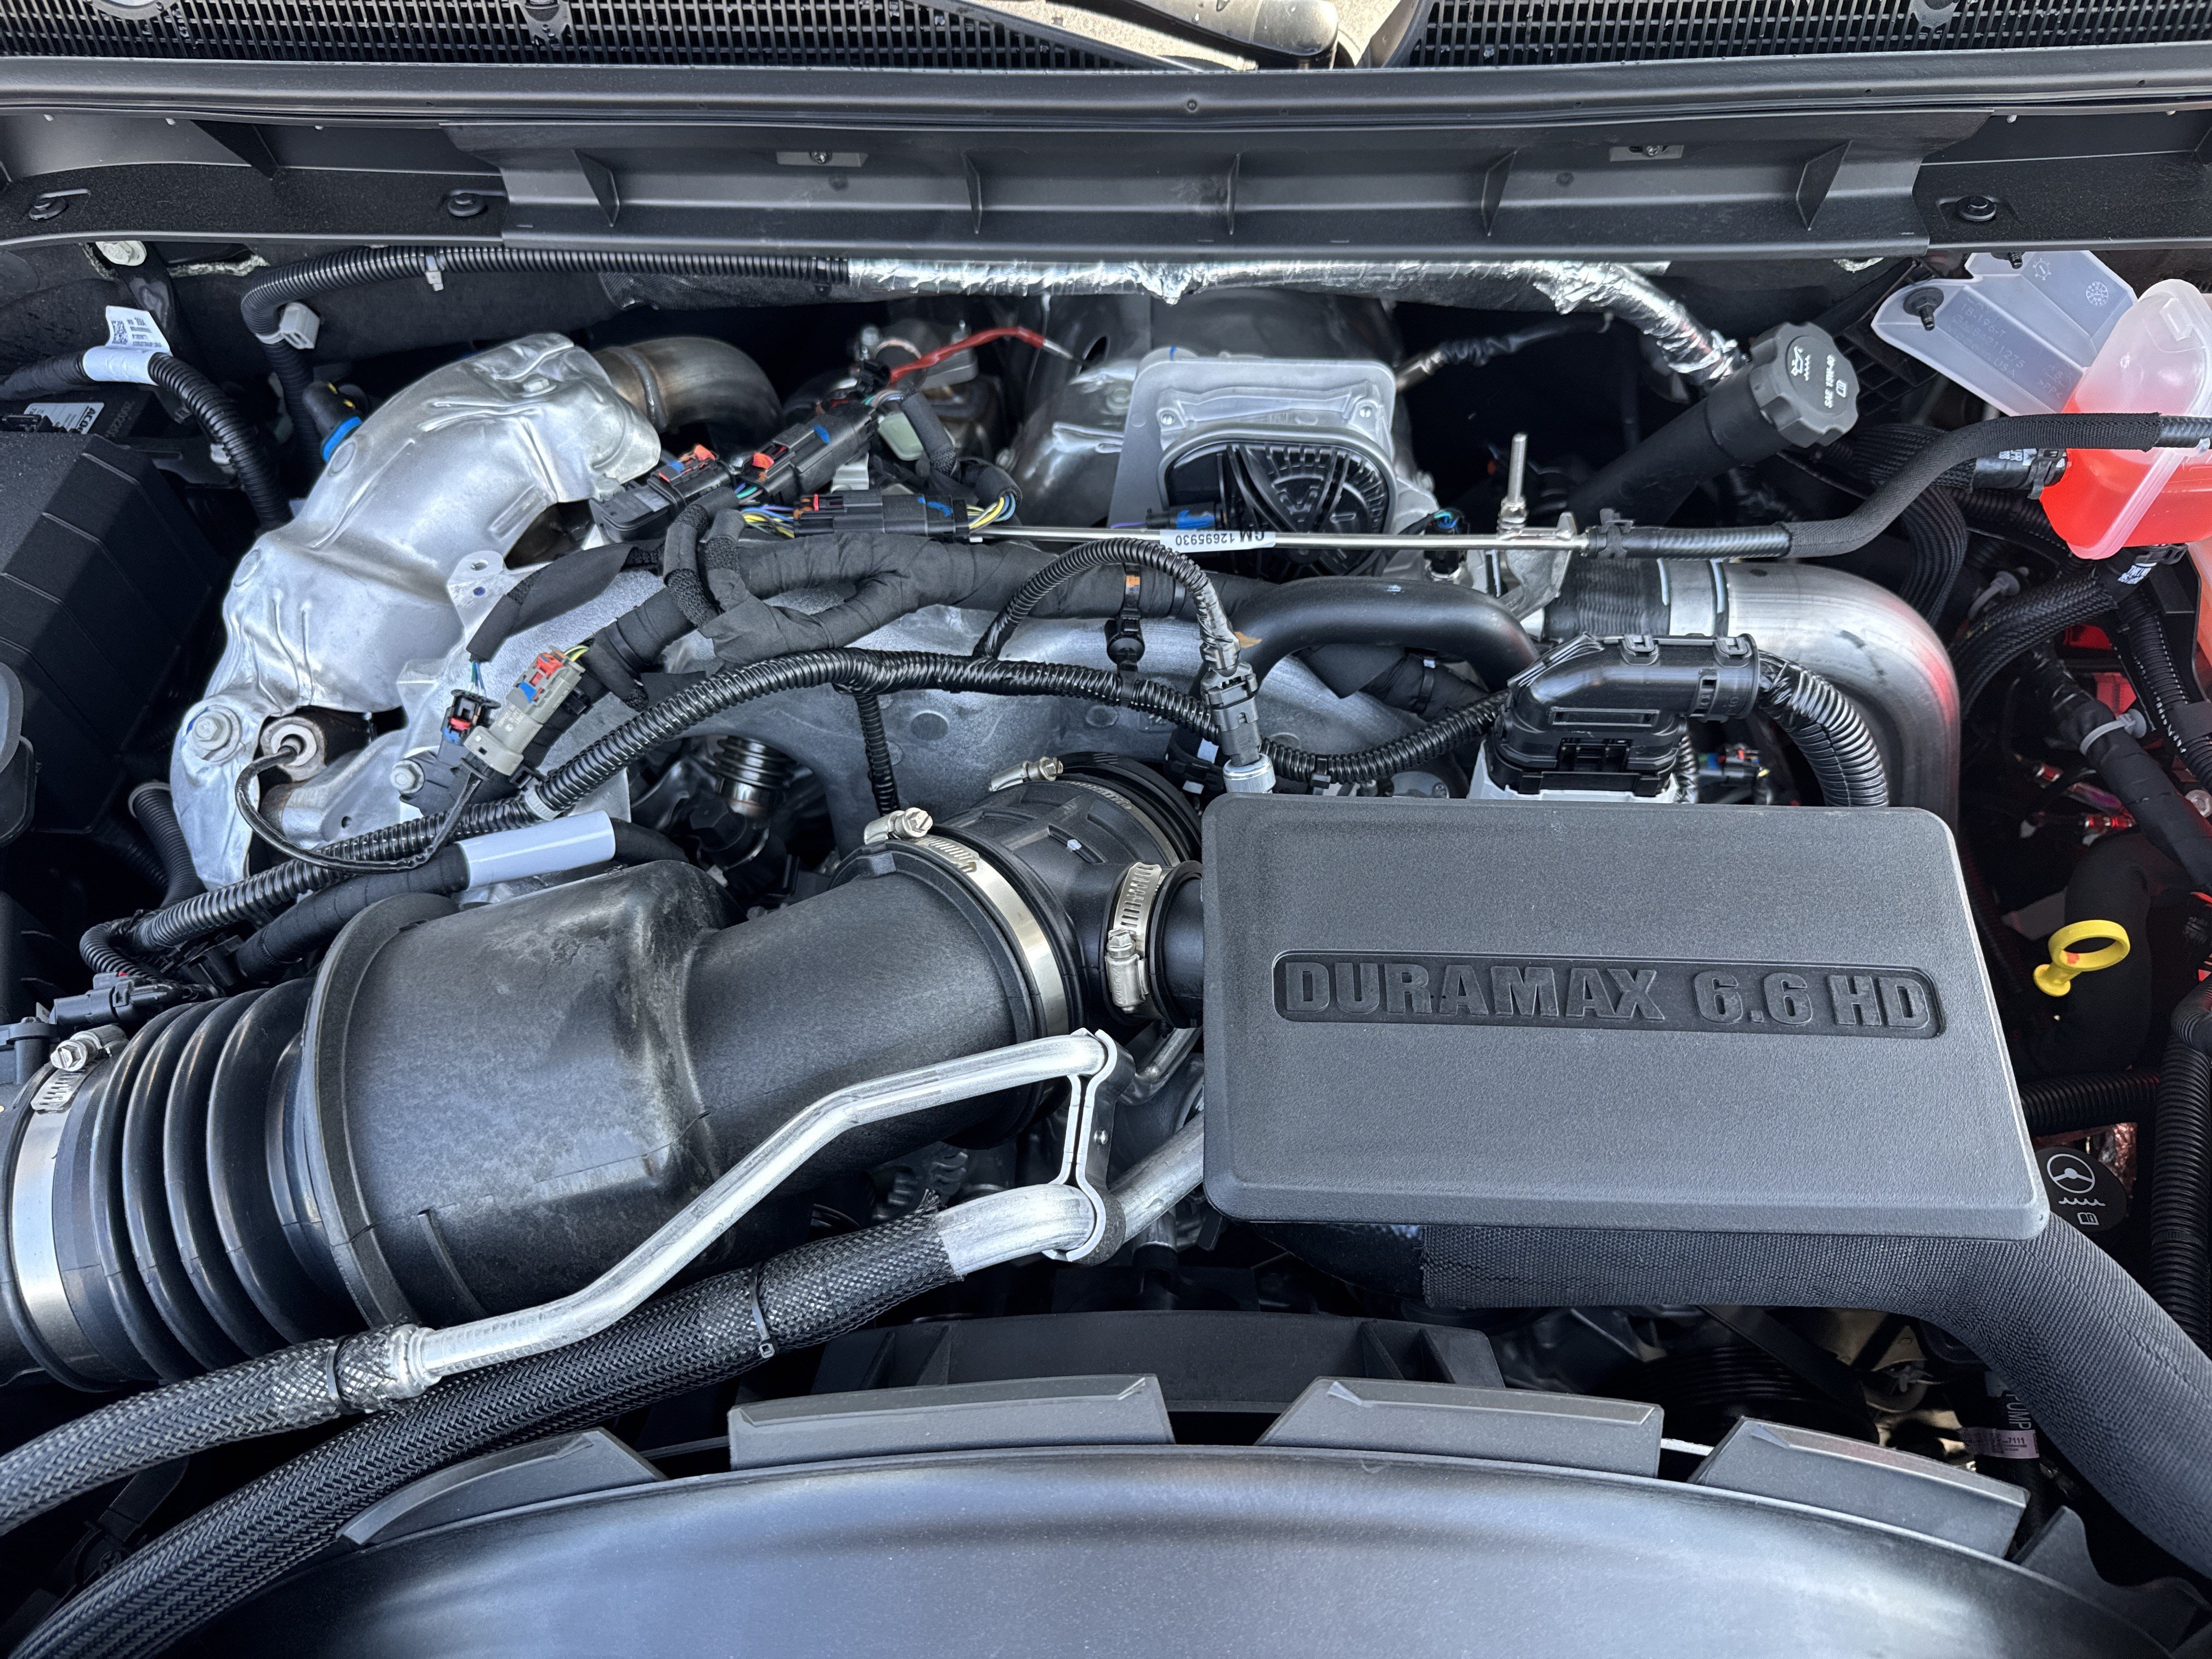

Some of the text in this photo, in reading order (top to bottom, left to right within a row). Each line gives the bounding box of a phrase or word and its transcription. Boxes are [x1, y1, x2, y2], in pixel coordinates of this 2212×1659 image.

[1825, 389, 1833, 408] SAE
[1176, 531, 1265, 546] GM 12695930
[1284, 961, 1931, 1029] DURAMAX 6.6 HD
